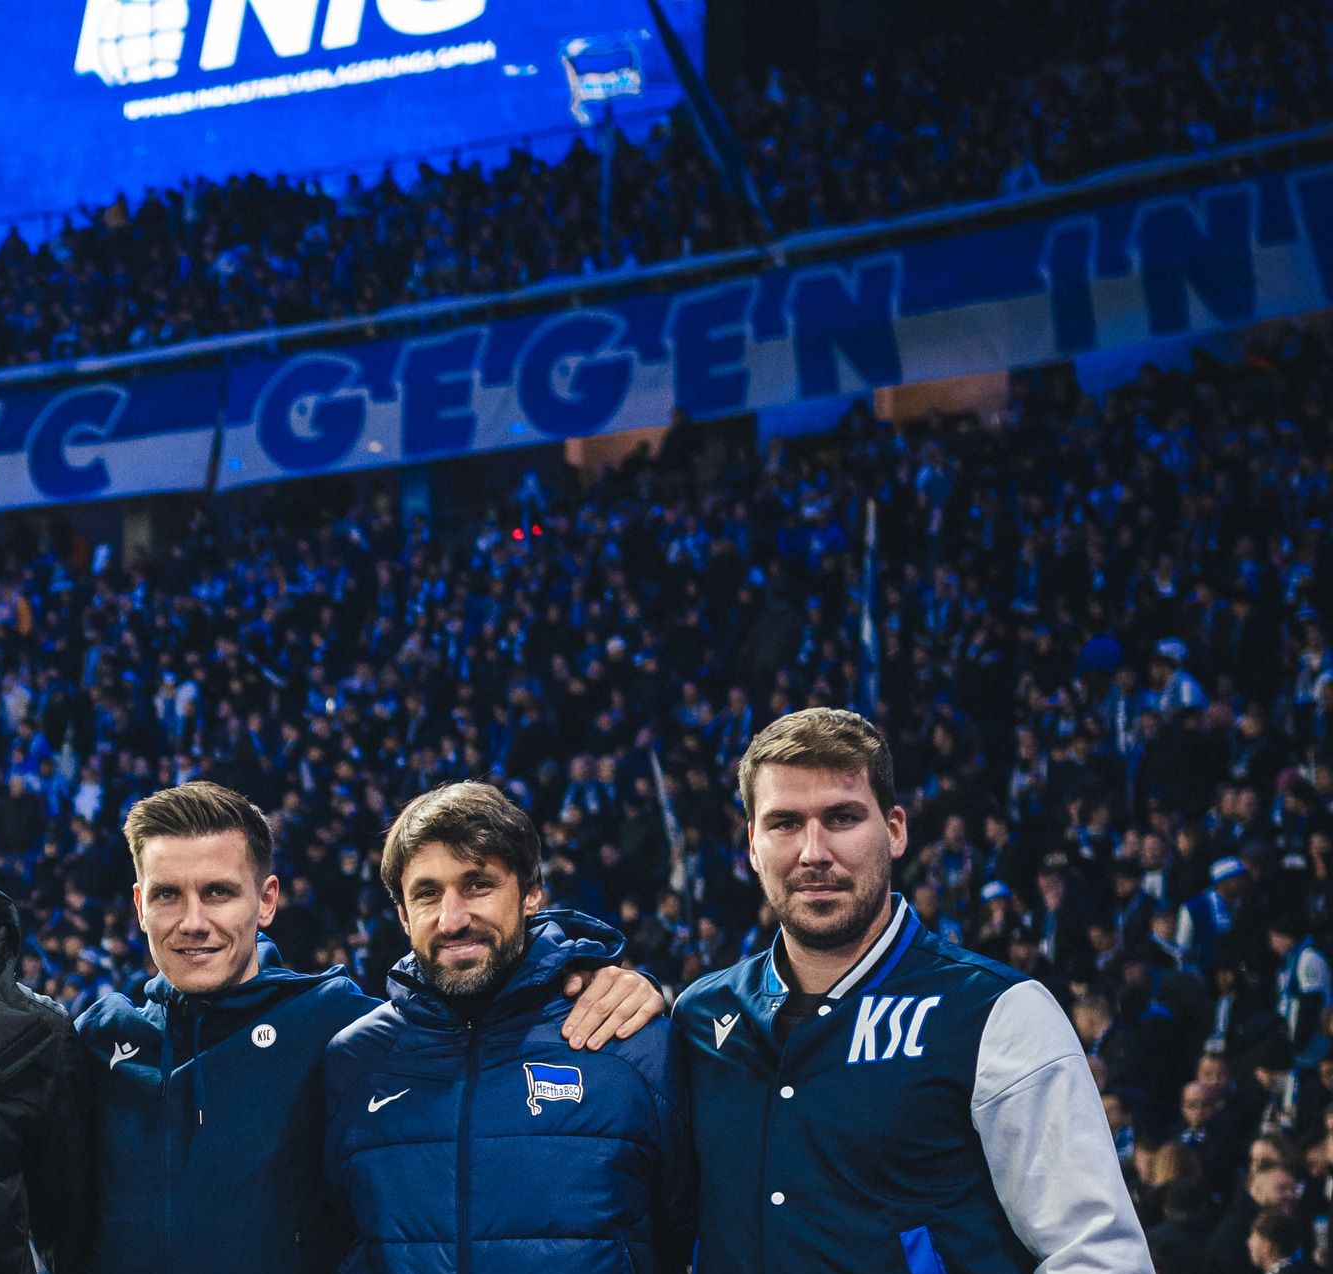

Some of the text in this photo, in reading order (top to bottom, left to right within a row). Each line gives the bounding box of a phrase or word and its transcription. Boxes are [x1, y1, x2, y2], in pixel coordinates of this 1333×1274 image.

[255, 252, 905, 473] GEGEN
[257, 1029, 271, 1042] KSC
[848, 996, 941, 1063] KSC
